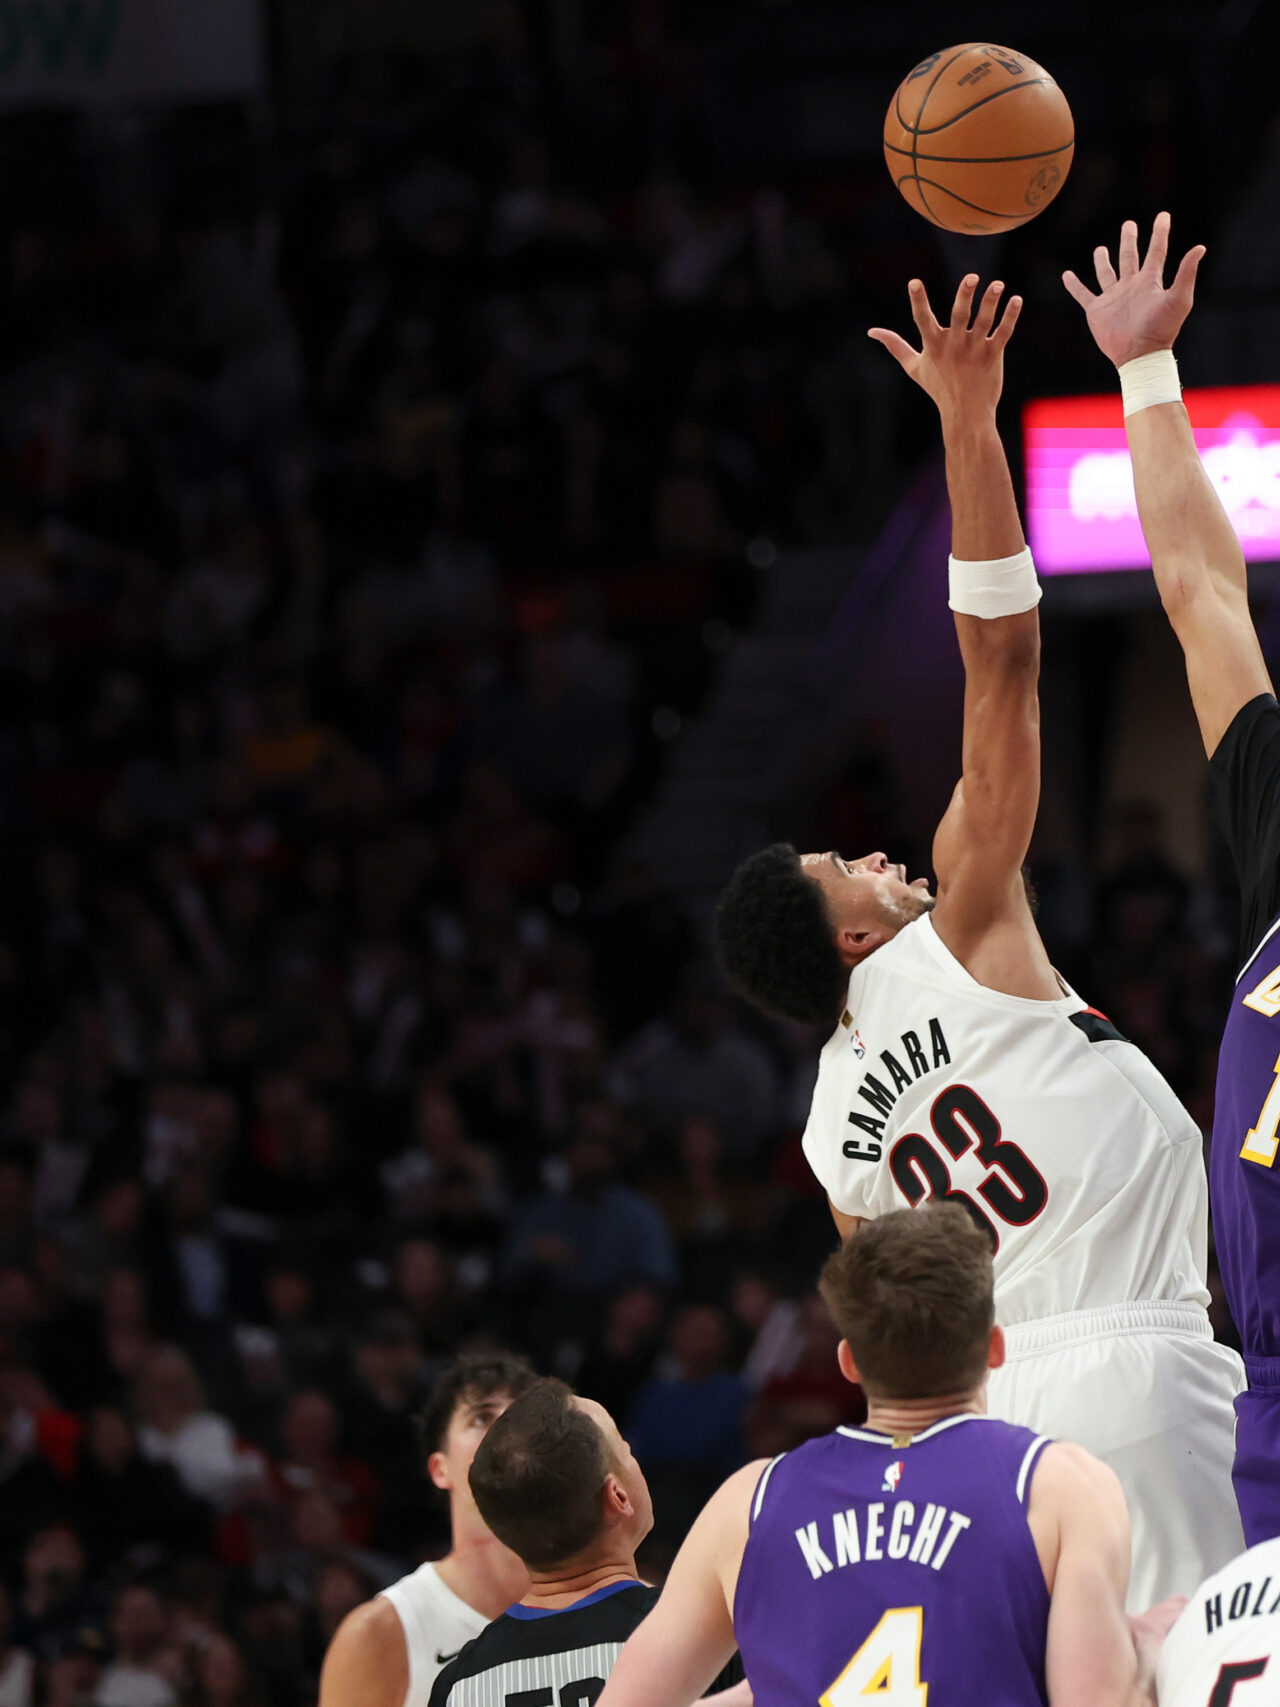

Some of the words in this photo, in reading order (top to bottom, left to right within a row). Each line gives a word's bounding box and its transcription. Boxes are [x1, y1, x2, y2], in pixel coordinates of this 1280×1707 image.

[842, 1017, 951, 1163] CAMARA
[794, 1499, 972, 1580] KNECHT
[818, 1605, 928, 1707] 4
